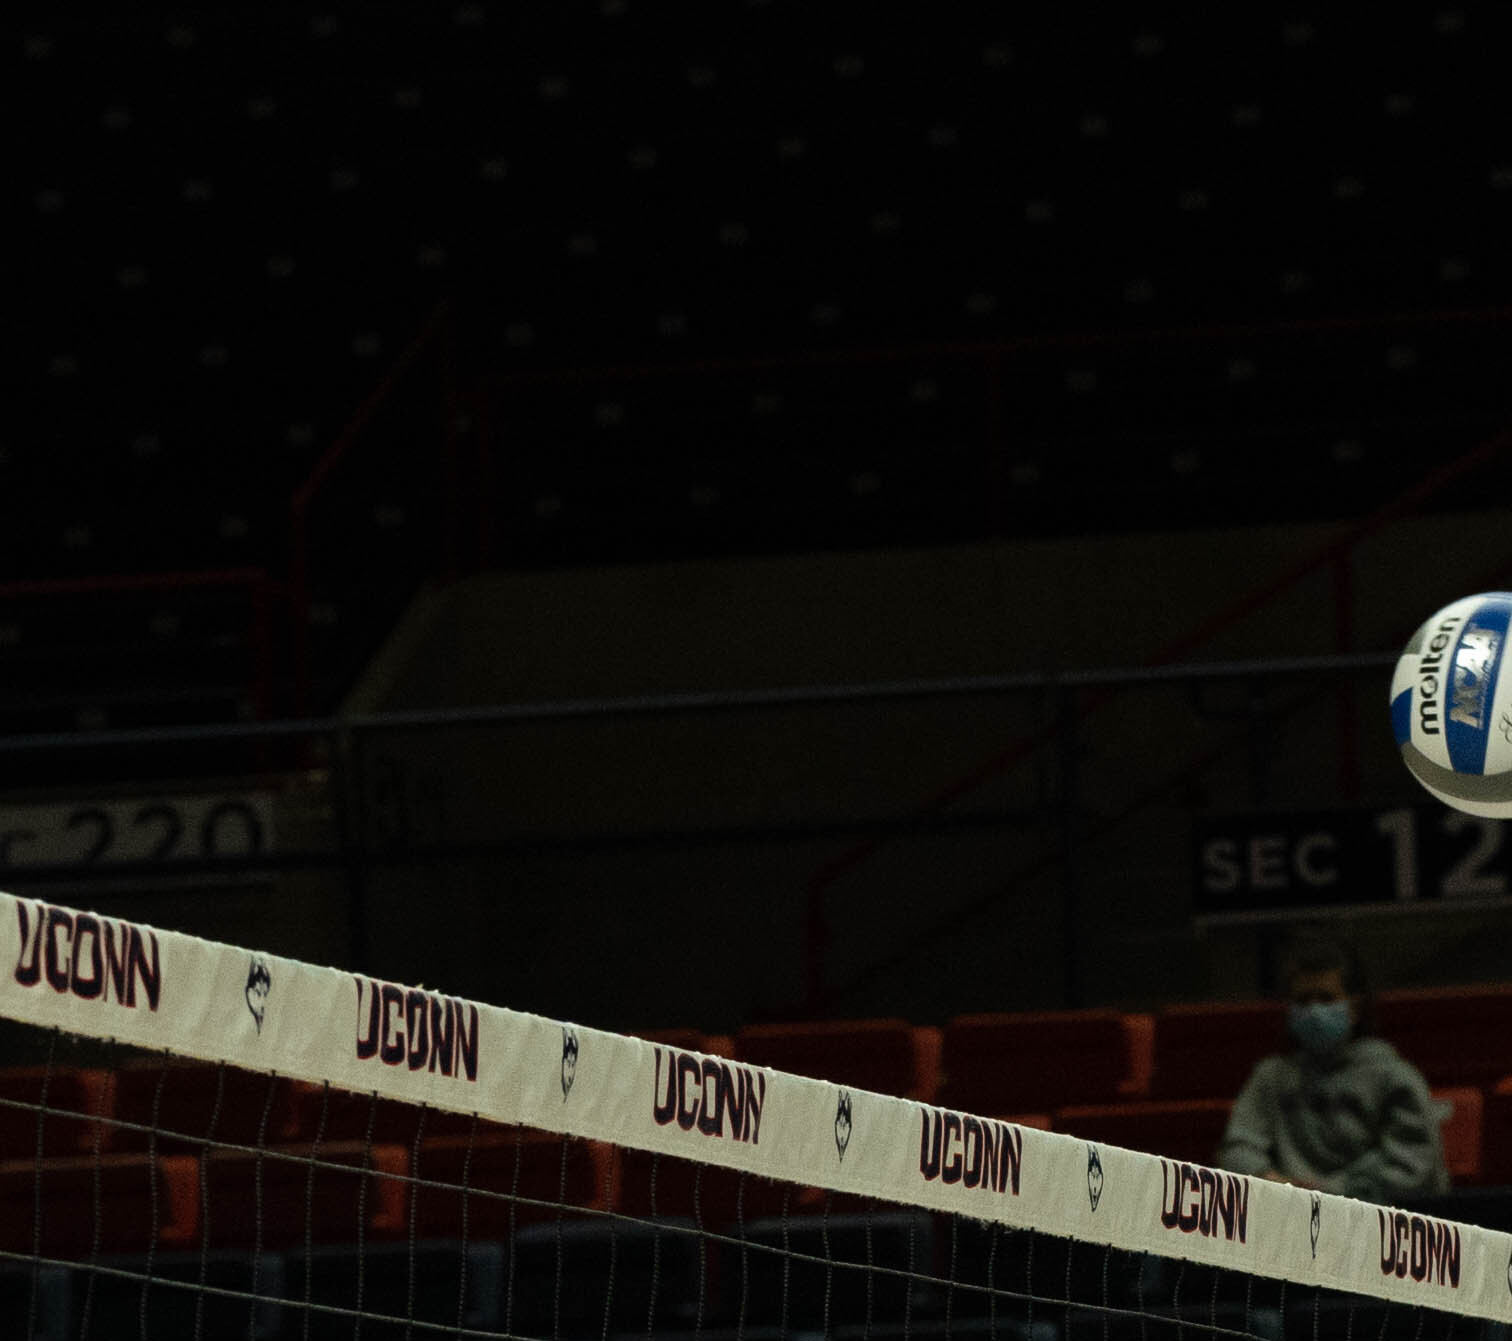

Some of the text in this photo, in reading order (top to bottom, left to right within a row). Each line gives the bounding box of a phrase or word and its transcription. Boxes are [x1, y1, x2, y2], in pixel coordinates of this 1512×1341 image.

[1419, 616, 1461, 736] molten
[67, 801, 265, 865] 220
[1200, 830, 1341, 891] SEC
[14, 900, 162, 1012] UCONN
[354, 976, 480, 1082] UCONN
[652, 1047, 767, 1145] UCONN
[918, 1106, 1024, 1196] UCONN
[1159, 1158, 1250, 1244] UCONN
[1377, 1207, 1461, 1289] UCONN
